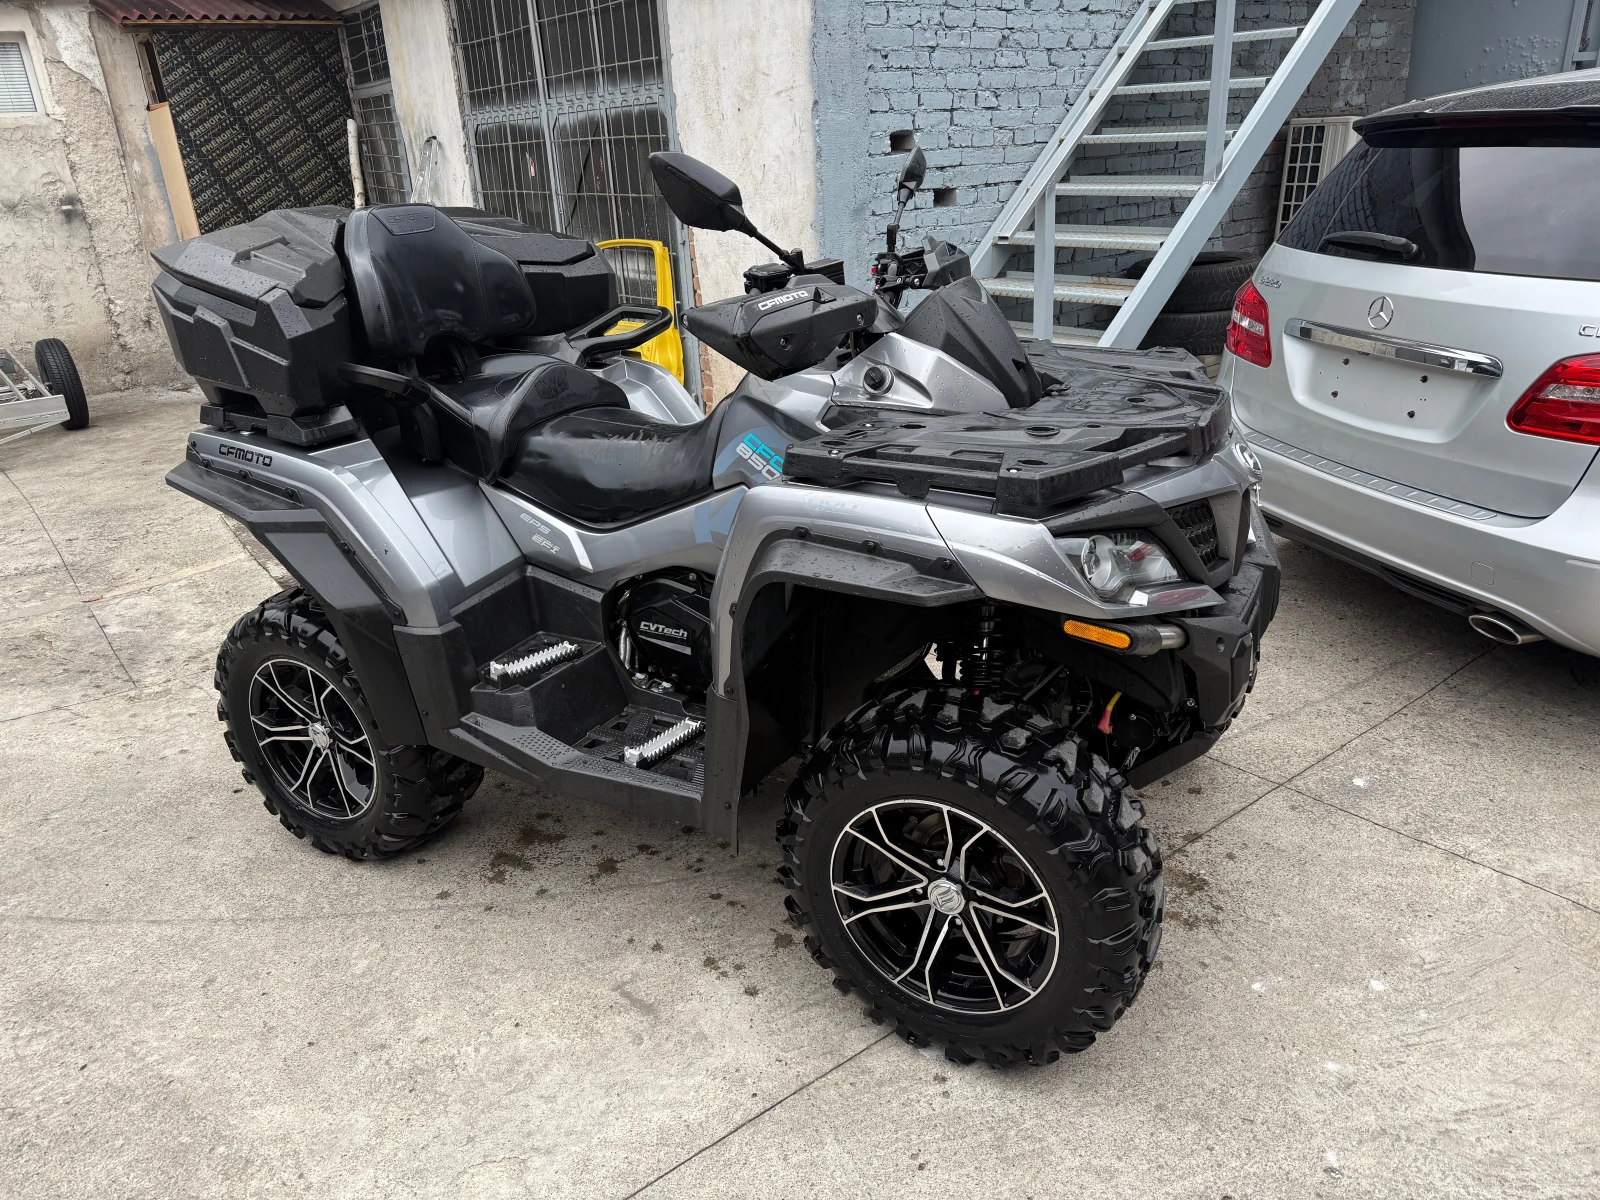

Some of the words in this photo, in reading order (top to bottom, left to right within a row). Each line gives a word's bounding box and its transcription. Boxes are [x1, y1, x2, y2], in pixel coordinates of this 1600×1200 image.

[184, 30, 213, 46] PHEN
[197, 33, 237, 62] PHENOPLY
[264, 36, 300, 64] PHENOPLY
[209, 49, 249, 78] PHENOPLY
[275, 51, 312, 79] PHENOPLY
[221, 64, 259, 93] PHENOPLY
[285, 66, 322, 95] PHENOPLY
[177, 93, 217, 123] PHENOPLY
[233, 79, 271, 109] PHENOPLY
[296, 81, 333, 110] PHENOPLY
[189, 109, 229, 138] PHENOPLY
[244, 95, 282, 124] PHENOPLY
[256, 109, 292, 139] PHENOPLY
[307, 96, 343, 124] PHENOPLY
[201, 124, 240, 154] PHENOPLY
[267, 125, 304, 153] PHENOPLY
[317, 111, 352, 139] PHENOPLY
[213, 138, 253, 168] PHENOPLY
[278, 139, 314, 168] PHENOPLY
[288, 153, 324, 182] PHENOPLY
[225, 154, 263, 183] PHENOPLY
[236, 168, 274, 197] PHENOPLY
[299, 167, 334, 196] PHENOPLY
[248, 182, 285, 211] PHENOPLY
[275, 196, 295, 210] OPLY
[217, 212, 244, 230] NOPLY
[757, 290, 809, 311] CFMOTO
[219, 443, 272, 467] CFMOTO
[736, 442, 780, 480] 850
[520, 512, 551, 534] EPS
[639, 621, 688, 638] CVTech
